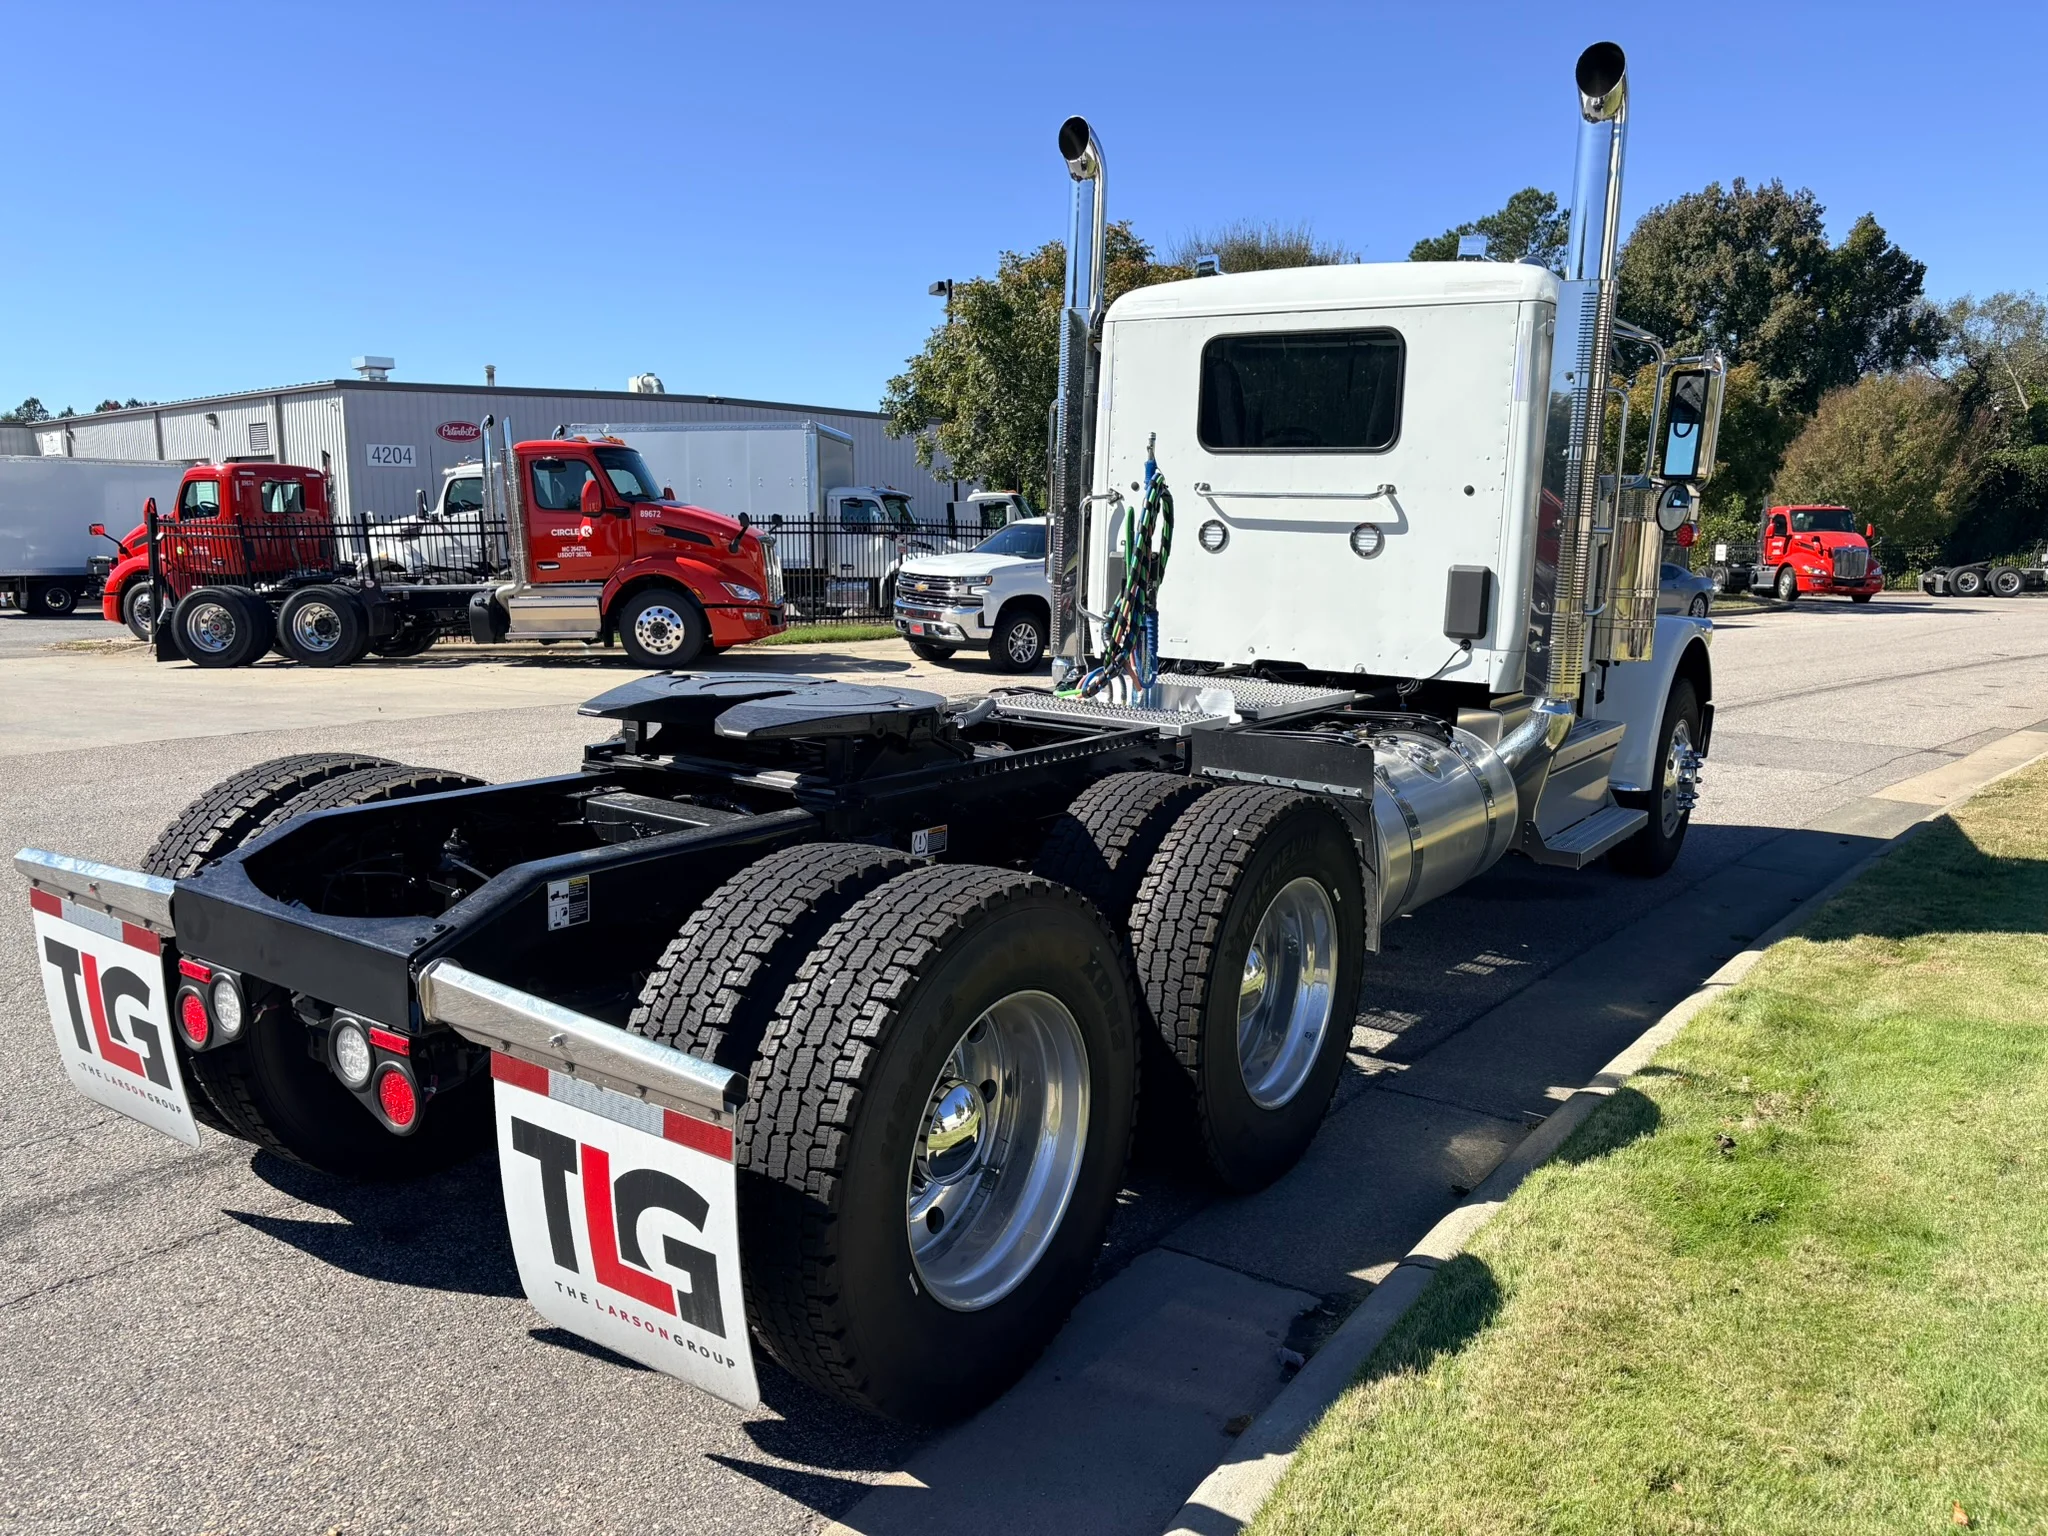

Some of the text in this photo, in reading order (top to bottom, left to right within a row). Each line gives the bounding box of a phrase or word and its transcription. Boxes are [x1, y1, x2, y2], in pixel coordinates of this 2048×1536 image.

[372, 446, 412, 464] 4204
[442, 424, 479, 437] Peterbilt
[551, 528, 580, 536] CIRCLE
[640, 510, 662, 518] 89672
[1243, 832, 1317, 934] MICHELIN
[44, 936, 173, 1090] TLG
[81, 1062, 182, 1114] THE LARSON GROUP
[511, 1115, 727, 1339] TLG
[554, 1281, 736, 1369] THE LARSON GROUP
